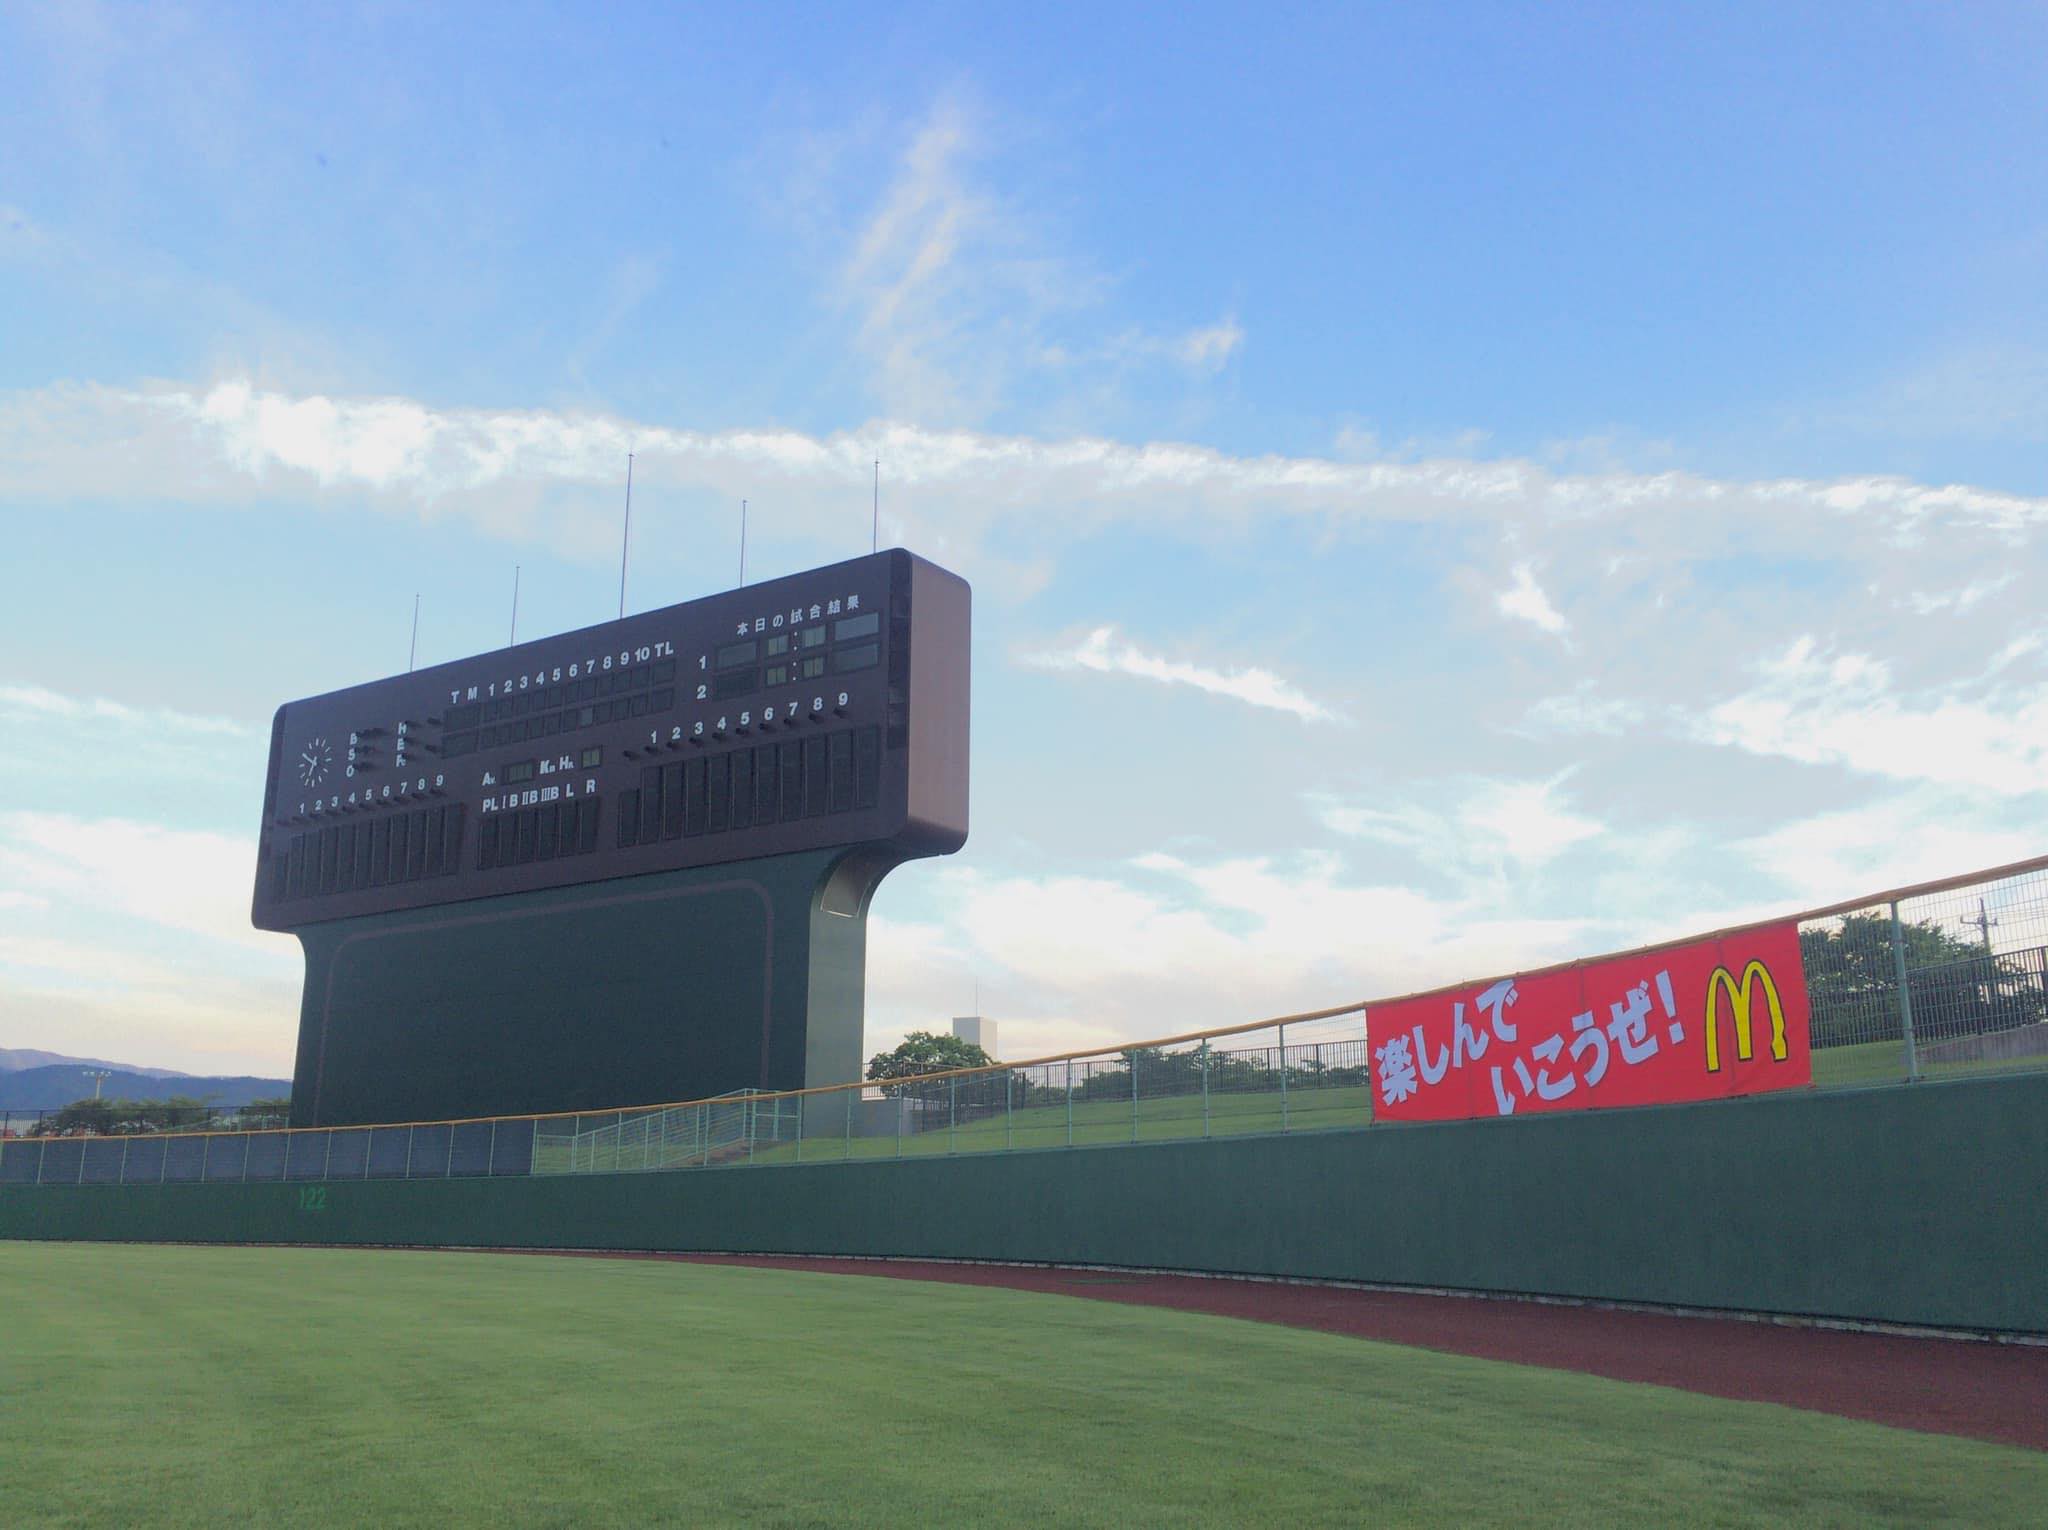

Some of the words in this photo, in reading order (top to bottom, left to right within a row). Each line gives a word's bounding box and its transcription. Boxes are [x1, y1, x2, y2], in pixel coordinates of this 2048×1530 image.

[736, 594, 860, 637] 本日の試合結果
[488, 683, 495, 697] 1
[503, 679, 513, 694] 2
[519, 675, 529, 689] 3
[535, 671, 545, 686] 4
[552, 667, 561, 682] 5
[568, 663, 578, 678] 6
[586, 658, 596, 674] 7
[602, 655, 612, 670] 8
[620, 651, 630, 666] 9
[634, 646, 650, 663] 10
[698, 655, 707, 670] 1
[696, 684, 707, 700] 2
[397, 722, 407, 736] H
[650, 730, 657, 744] 1
[671, 726, 681, 740] 2
[694, 721, 704, 735] 3
[716, 716, 727, 730] 4
[740, 711, 750, 726] 5
[763, 706, 774, 721] 6
[788, 701, 799, 717] 7
[812, 696, 823, 712] 8
[838, 692, 849, 706] 9
[396, 737, 405, 752] E
[299, 802, 305, 814] 1
[314, 799, 323, 811] 2
[331, 795, 339, 808] 3
[348, 791, 356, 804] 4
[365, 788, 373, 801] 5
[382, 785, 390, 798] 6
[400, 781, 408, 795] 7
[417, 778, 426, 791] 8
[435, 774, 444, 787] 9
[482, 797, 499, 813] PL
[565, 783, 575, 798] L
[585, 778, 596, 794] R
[1374, 978, 1519, 1107] 楽しんで
[300, 1186, 326, 1210] 122
